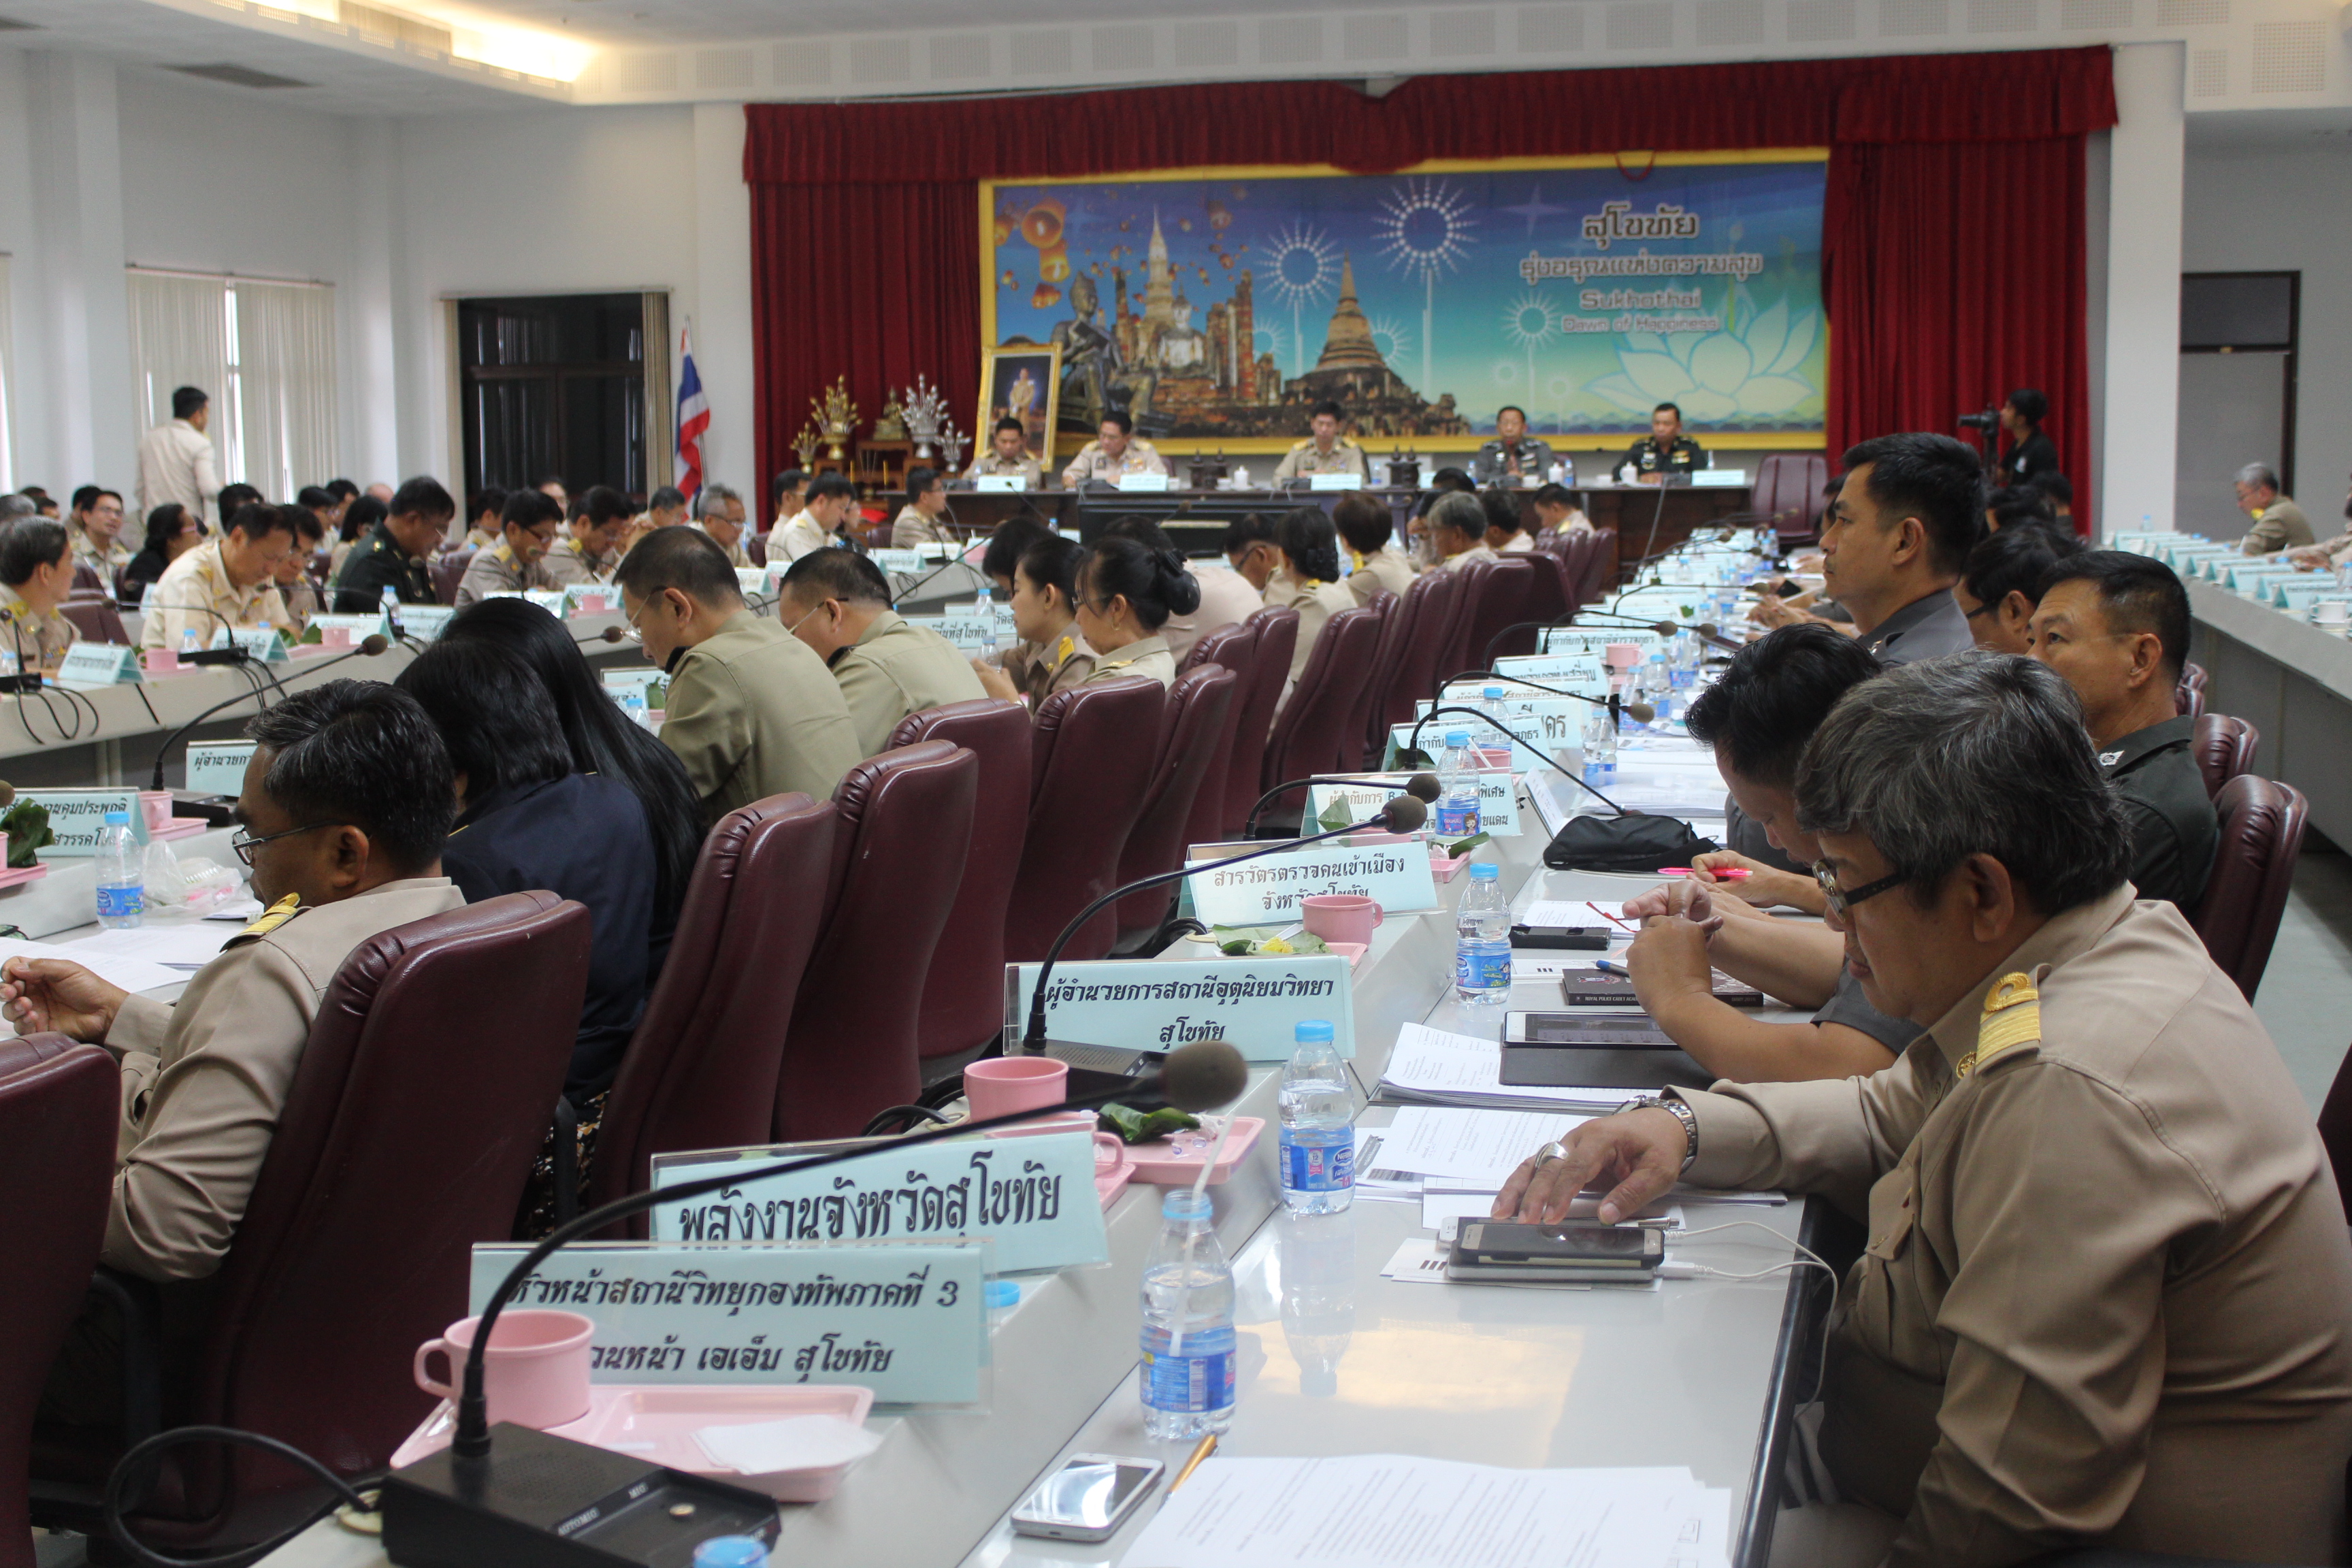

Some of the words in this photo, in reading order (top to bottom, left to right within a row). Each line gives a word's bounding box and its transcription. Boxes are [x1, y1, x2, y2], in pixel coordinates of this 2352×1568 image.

[1584, 203, 1698, 248] สุโขทัย
[1520, 250, 1763, 284] รุ่งอรุณแห่งความสุข
[1580, 287, 1701, 310] Sukhothai
[1562, 315, 1610, 333] Dawn
[1613, 314, 1630, 332] of
[1635, 314, 1720, 336] Happiness
[1214, 852, 1405, 887] สารวัตรตรวจคนเข้าเมือง
[1045, 973, 1334, 1010] ผู้อำนวยการสถานีอุตุนิยมวิทยา
[1159, 1016, 1226, 1051] สุโขทัย
[679, 1151, 1062, 1250] พลังงานจังหวัดสุโขทัย
[936, 1281, 959, 1307] 3
[697, 1335, 783, 1371] เอเอ็ม
[794, 1333, 895, 1383] สุโขทัย
